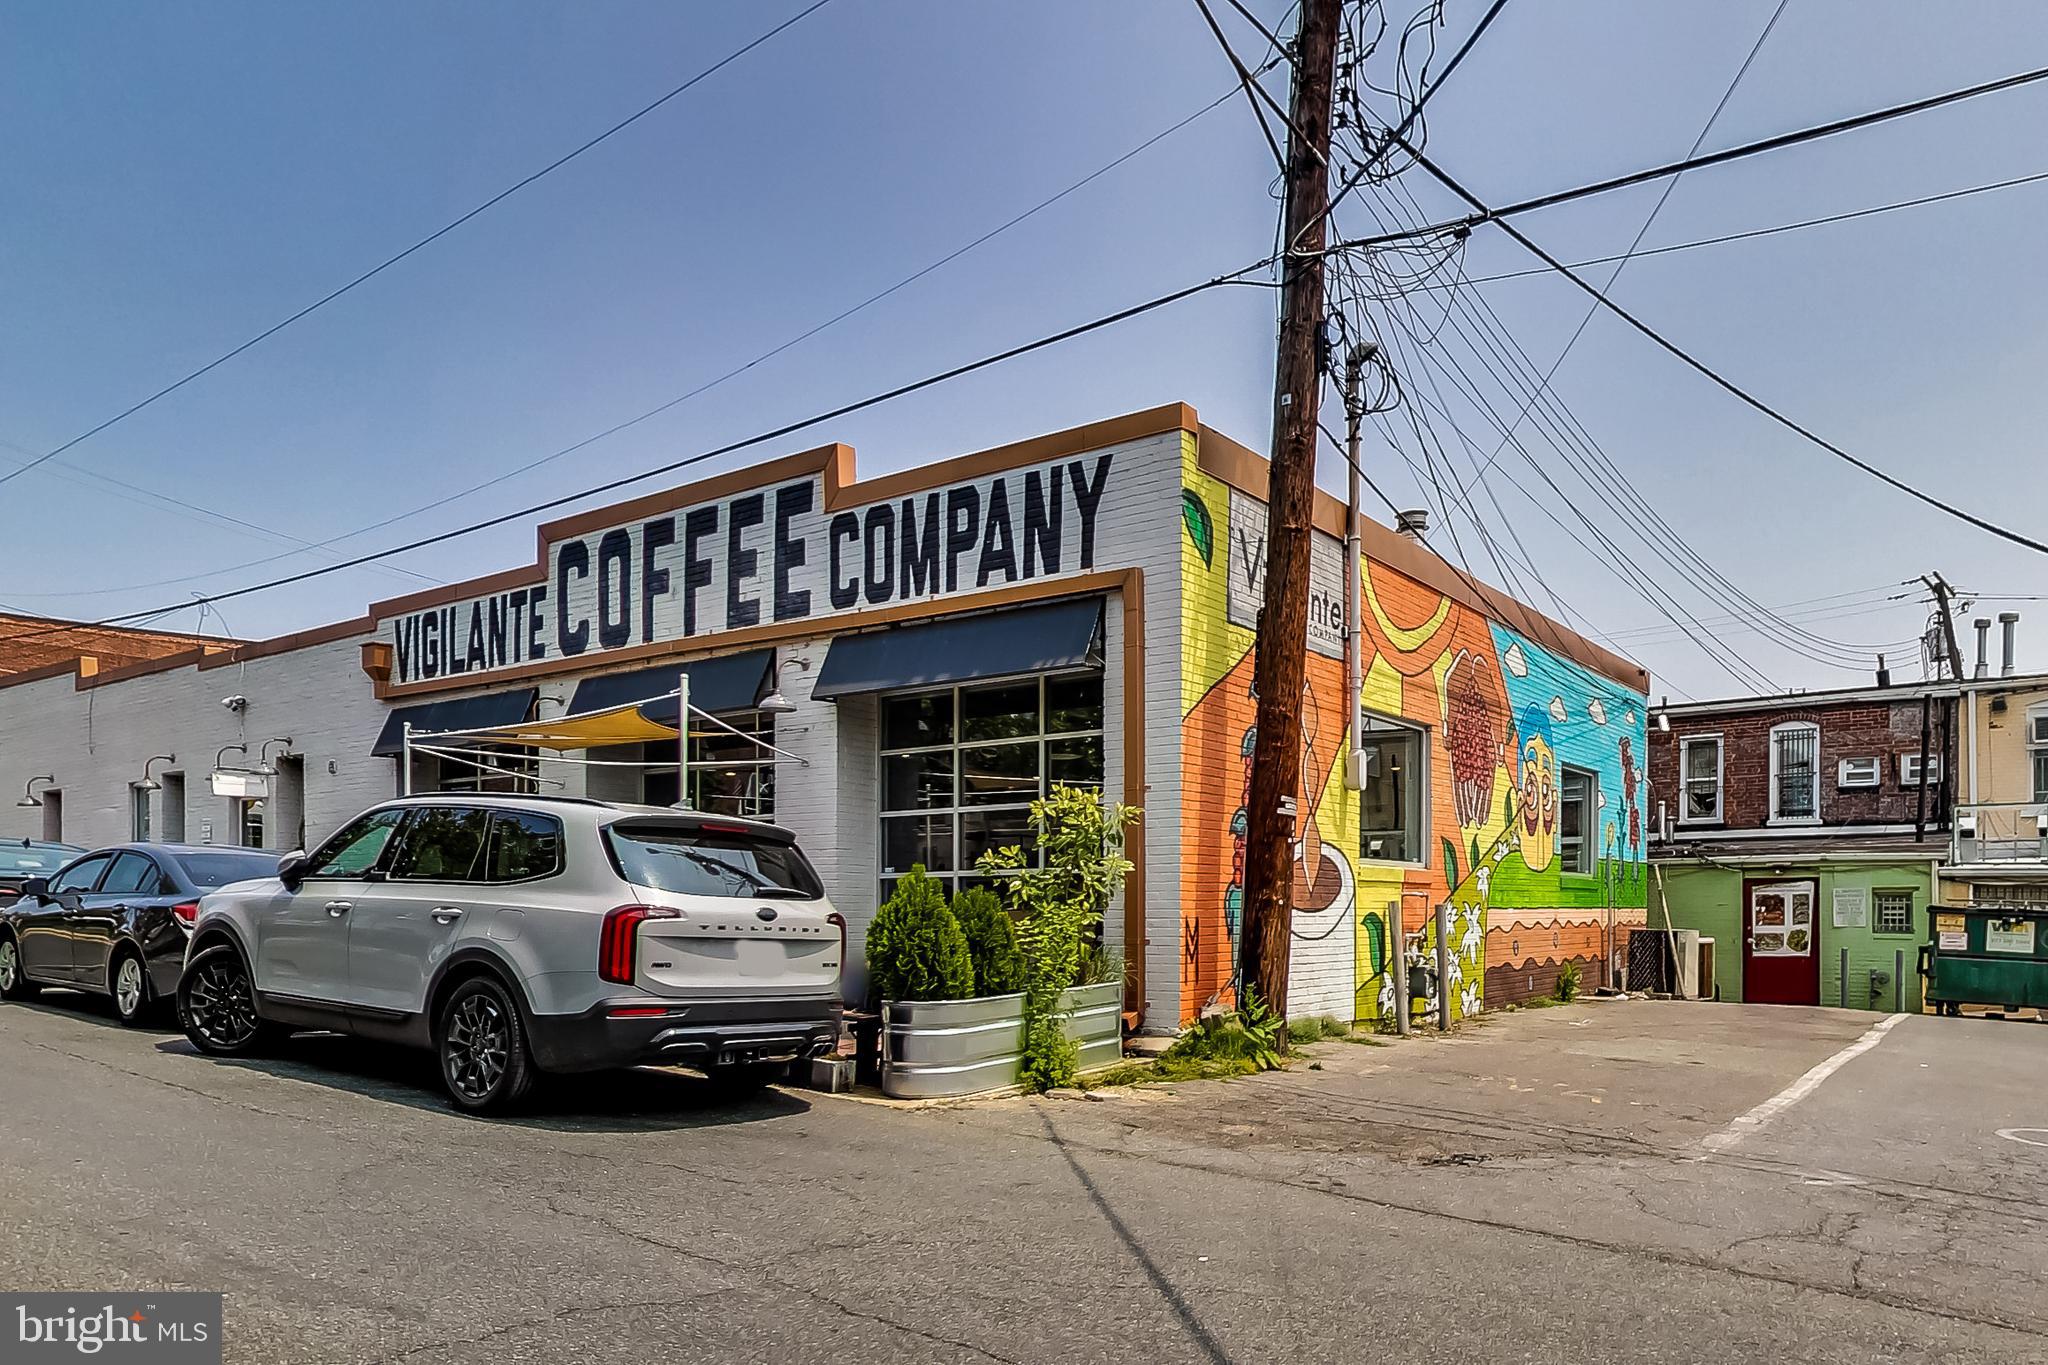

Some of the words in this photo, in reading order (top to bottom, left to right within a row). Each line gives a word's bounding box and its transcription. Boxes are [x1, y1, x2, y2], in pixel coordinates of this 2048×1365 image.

[394, 586, 548, 683] VIGILANTE
[557, 480, 814, 657] COFFEE
[829, 453, 1114, 610] COMPANY
